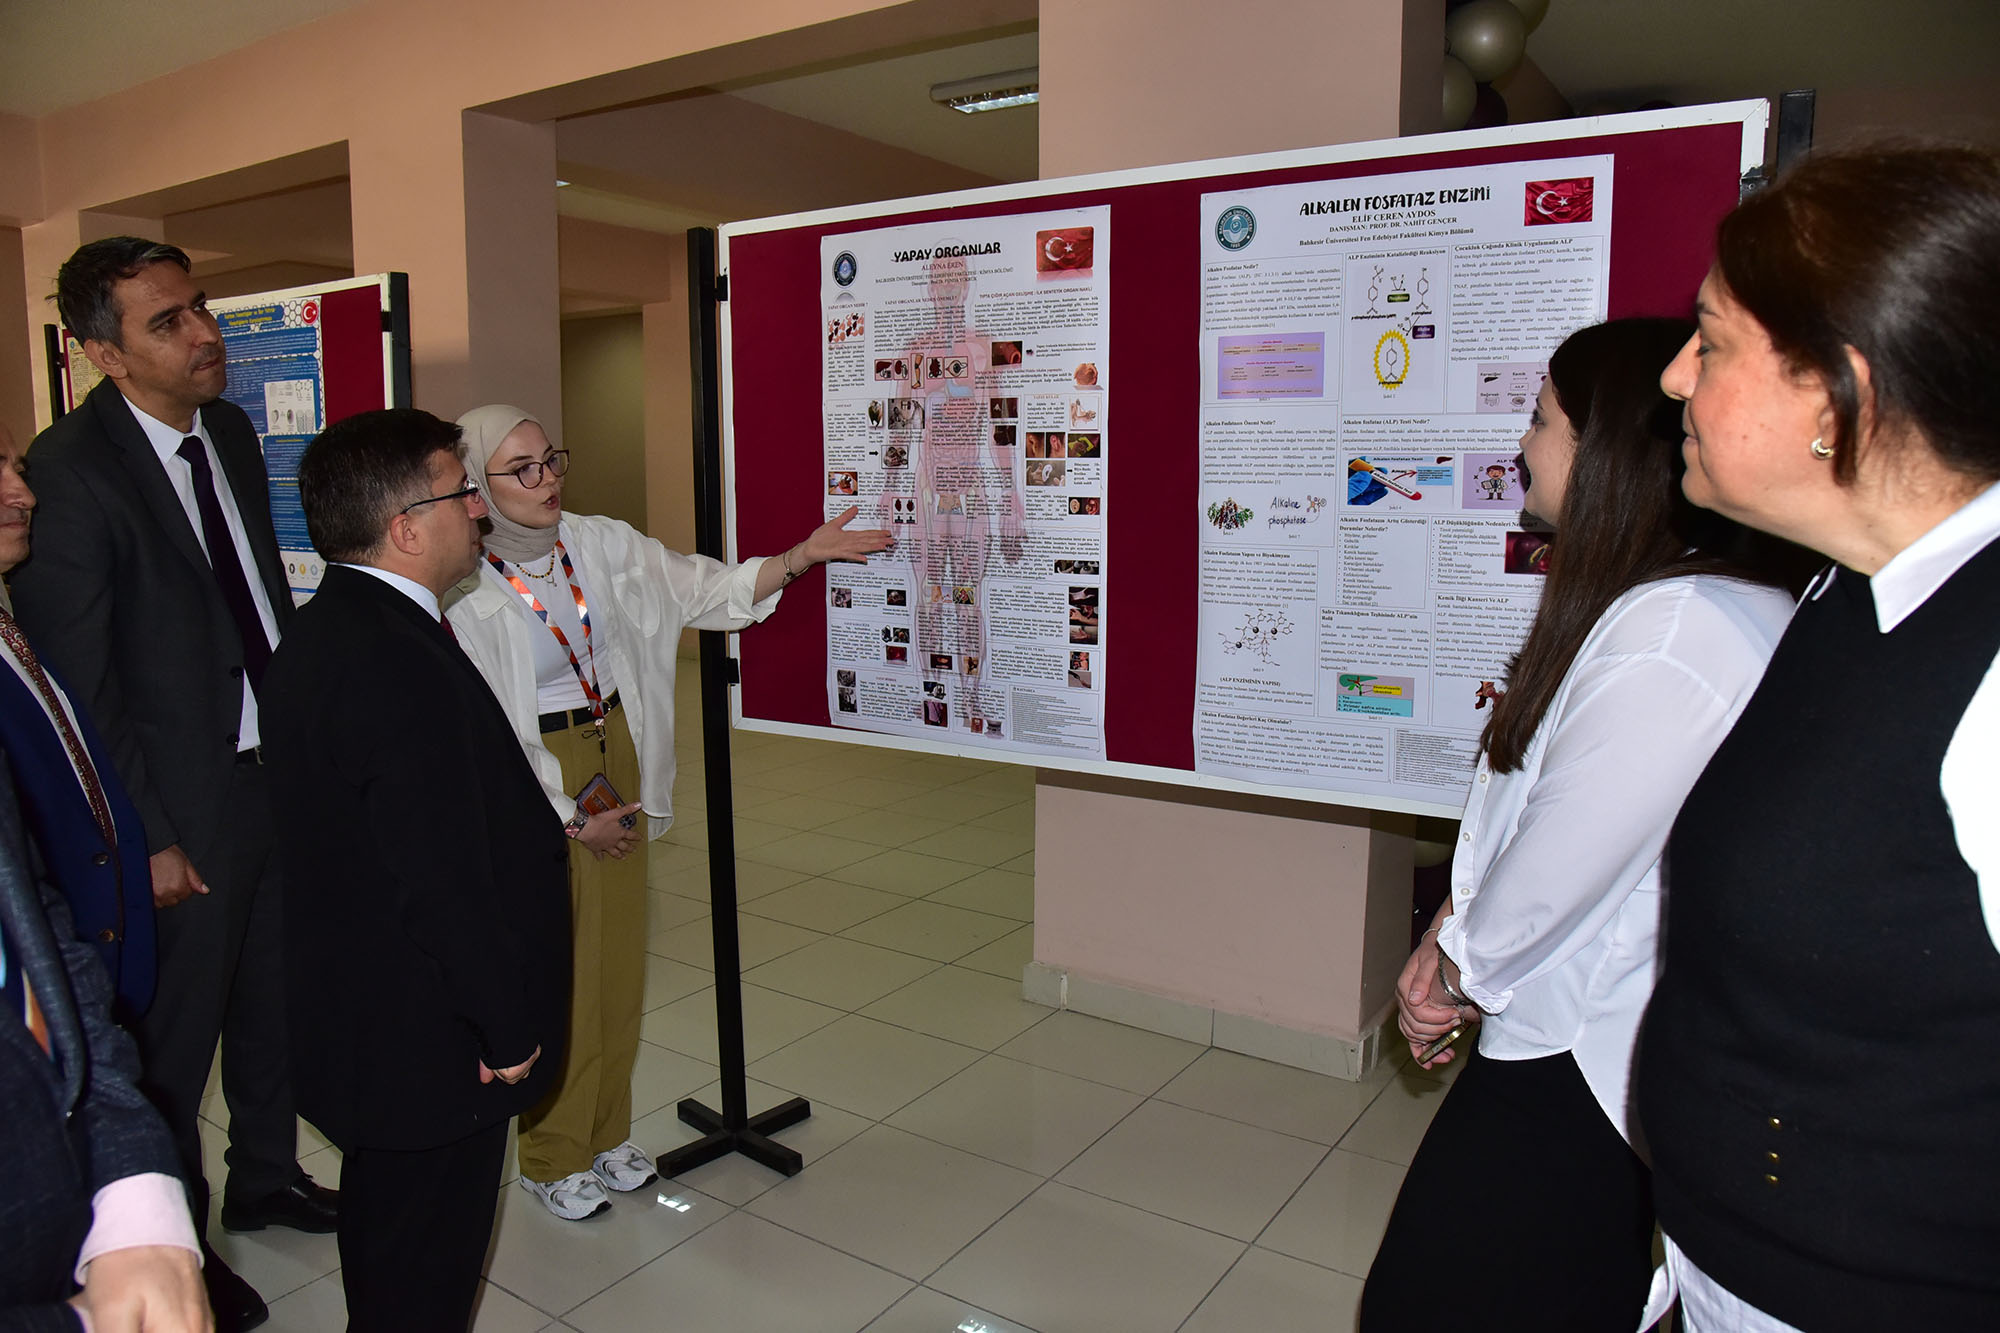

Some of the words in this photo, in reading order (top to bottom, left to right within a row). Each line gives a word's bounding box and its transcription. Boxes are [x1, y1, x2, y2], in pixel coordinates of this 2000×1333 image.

[1299, 198, 1360, 216] ALKALEN
[1364, 191, 1435, 211] FOSFATAZ
[1439, 186, 1491, 204] ENZİMİ
[1352, 214, 1372, 223] ELİF
[1373, 212, 1404, 222] CEREN
[1406, 209, 1436, 219] AYDOS
[1329, 224, 1368, 233] DANIŞMAN:
[1369, 222, 1389, 230] PROF.
[1403, 219, 1426, 227] NAHİT
[1427, 217, 1457, 226] GENÇER
[894, 248, 932, 262] YAPAY
[935, 242, 1001, 259] ORGANLAR
[922, 263, 946, 271] ALEYNA
